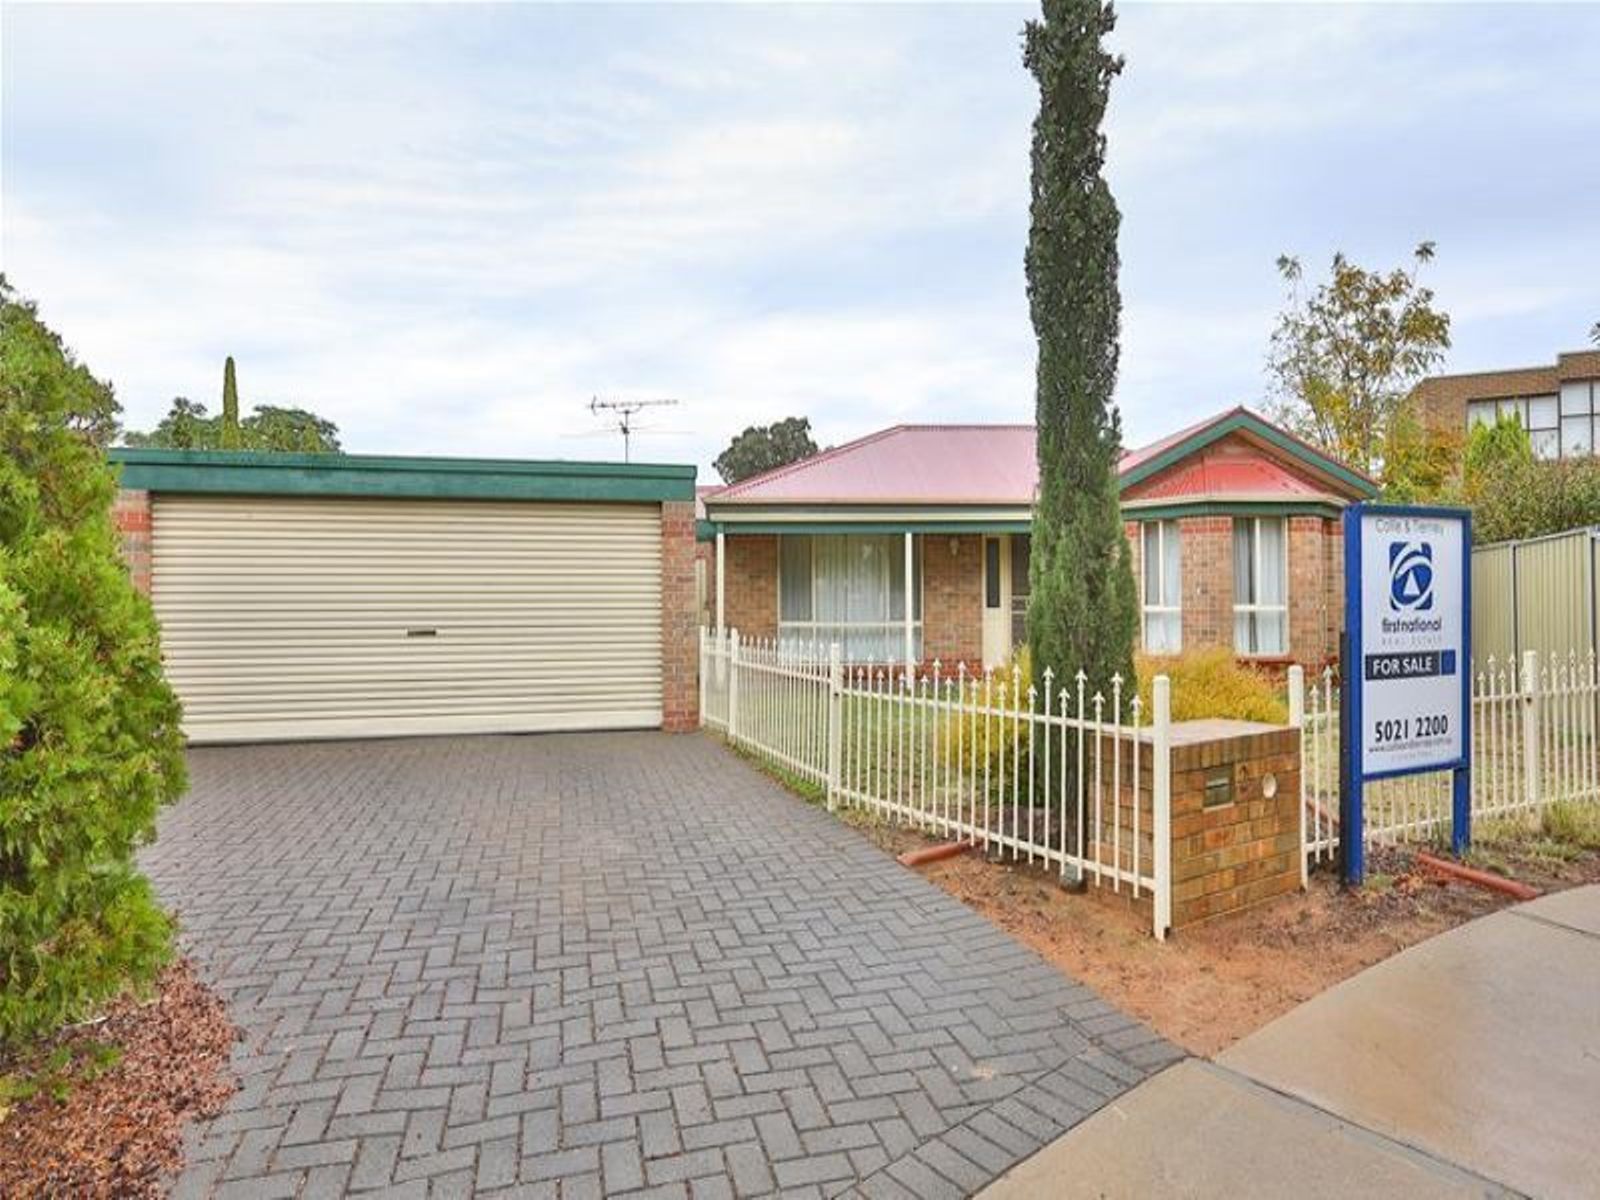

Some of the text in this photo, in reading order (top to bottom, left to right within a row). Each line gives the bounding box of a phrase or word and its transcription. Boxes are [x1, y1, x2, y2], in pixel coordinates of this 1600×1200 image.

[1373, 656, 1433, 676] FOR SALE
[1375, 714, 1448, 743] 5021 2200
